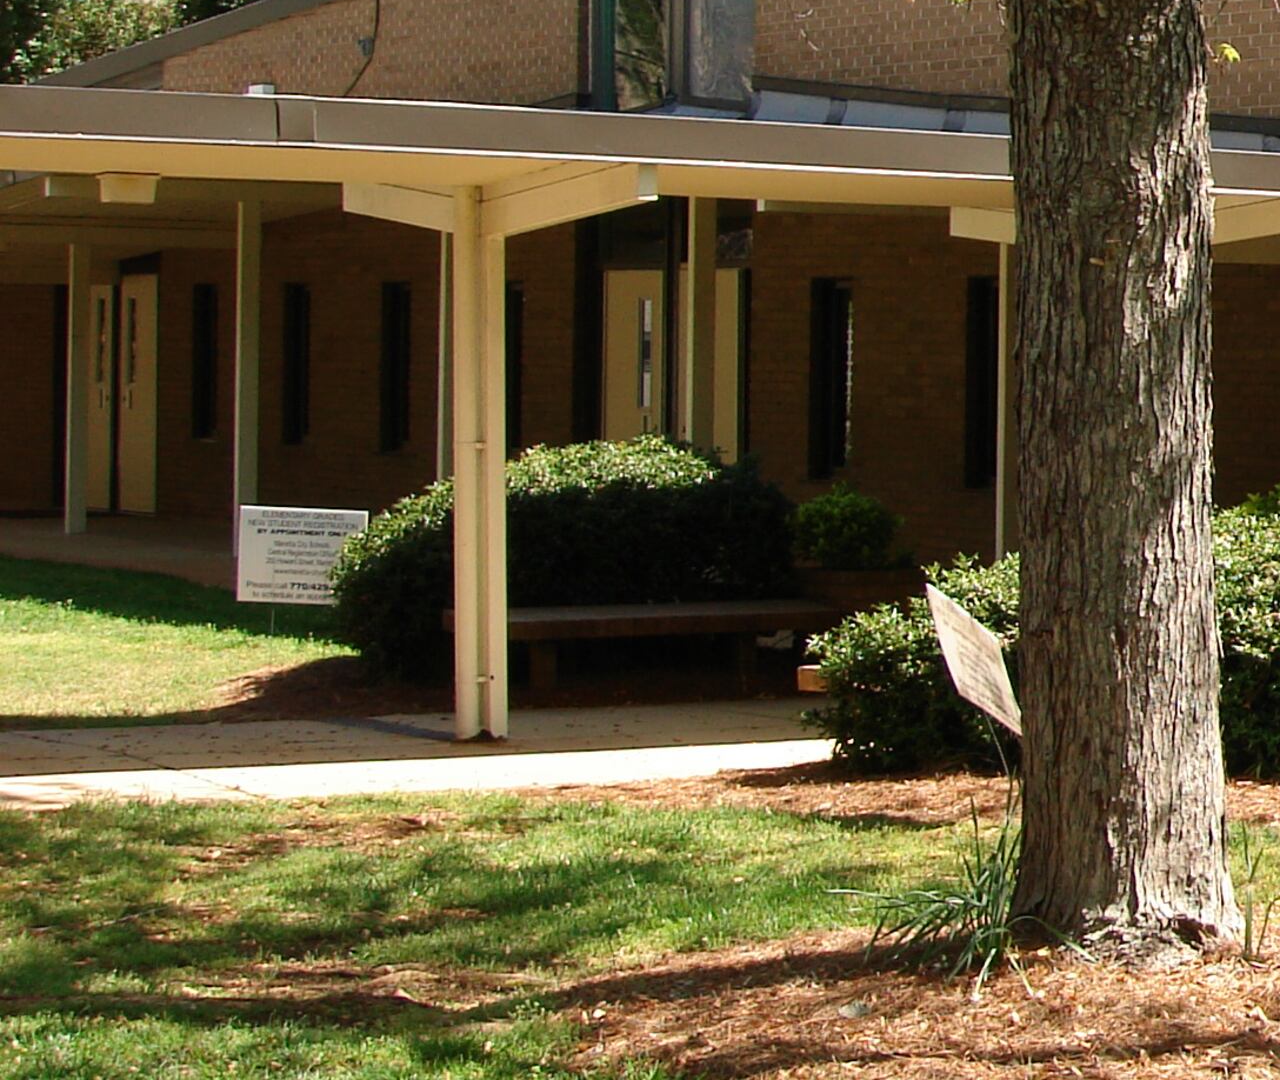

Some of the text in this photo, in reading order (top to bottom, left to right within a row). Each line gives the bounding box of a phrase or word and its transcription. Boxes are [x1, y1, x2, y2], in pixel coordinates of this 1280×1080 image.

[262, 510, 344, 520] ELEMENTARY GRADES
[248, 519, 358, 529] NEW STUDENT REGISTRATION
[270, 529, 325, 537] APPOINTMENT
[327, 530, 348, 538] ONLY
